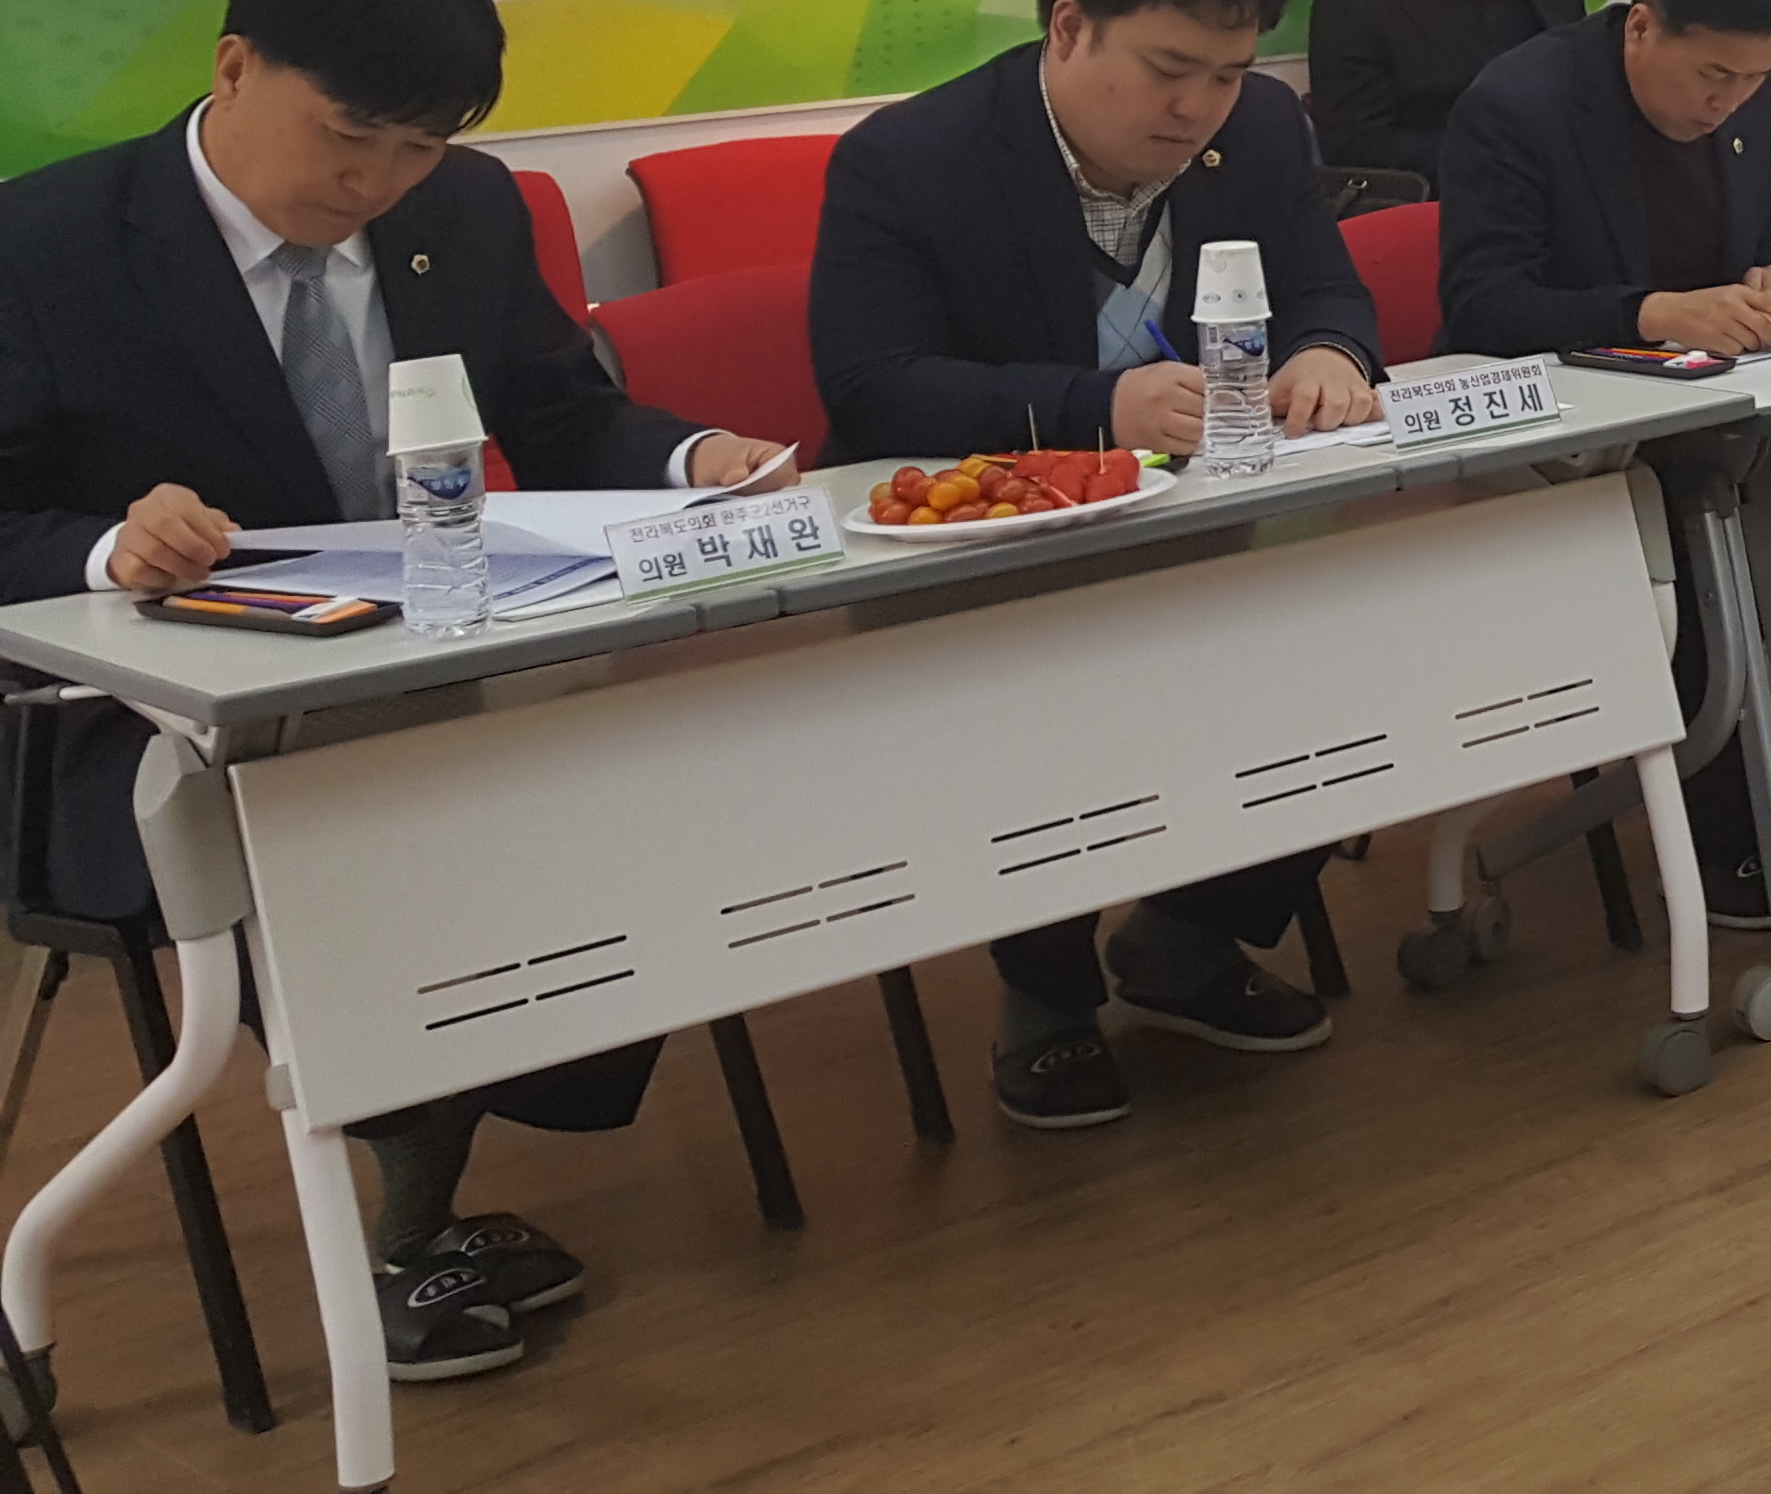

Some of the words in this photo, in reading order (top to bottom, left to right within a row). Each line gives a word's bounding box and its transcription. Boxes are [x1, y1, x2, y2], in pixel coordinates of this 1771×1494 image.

[1390, 380, 1456, 403] 전라북도의회
[1405, 410, 1442, 434] 의원
[639, 552, 687, 582] 의원
